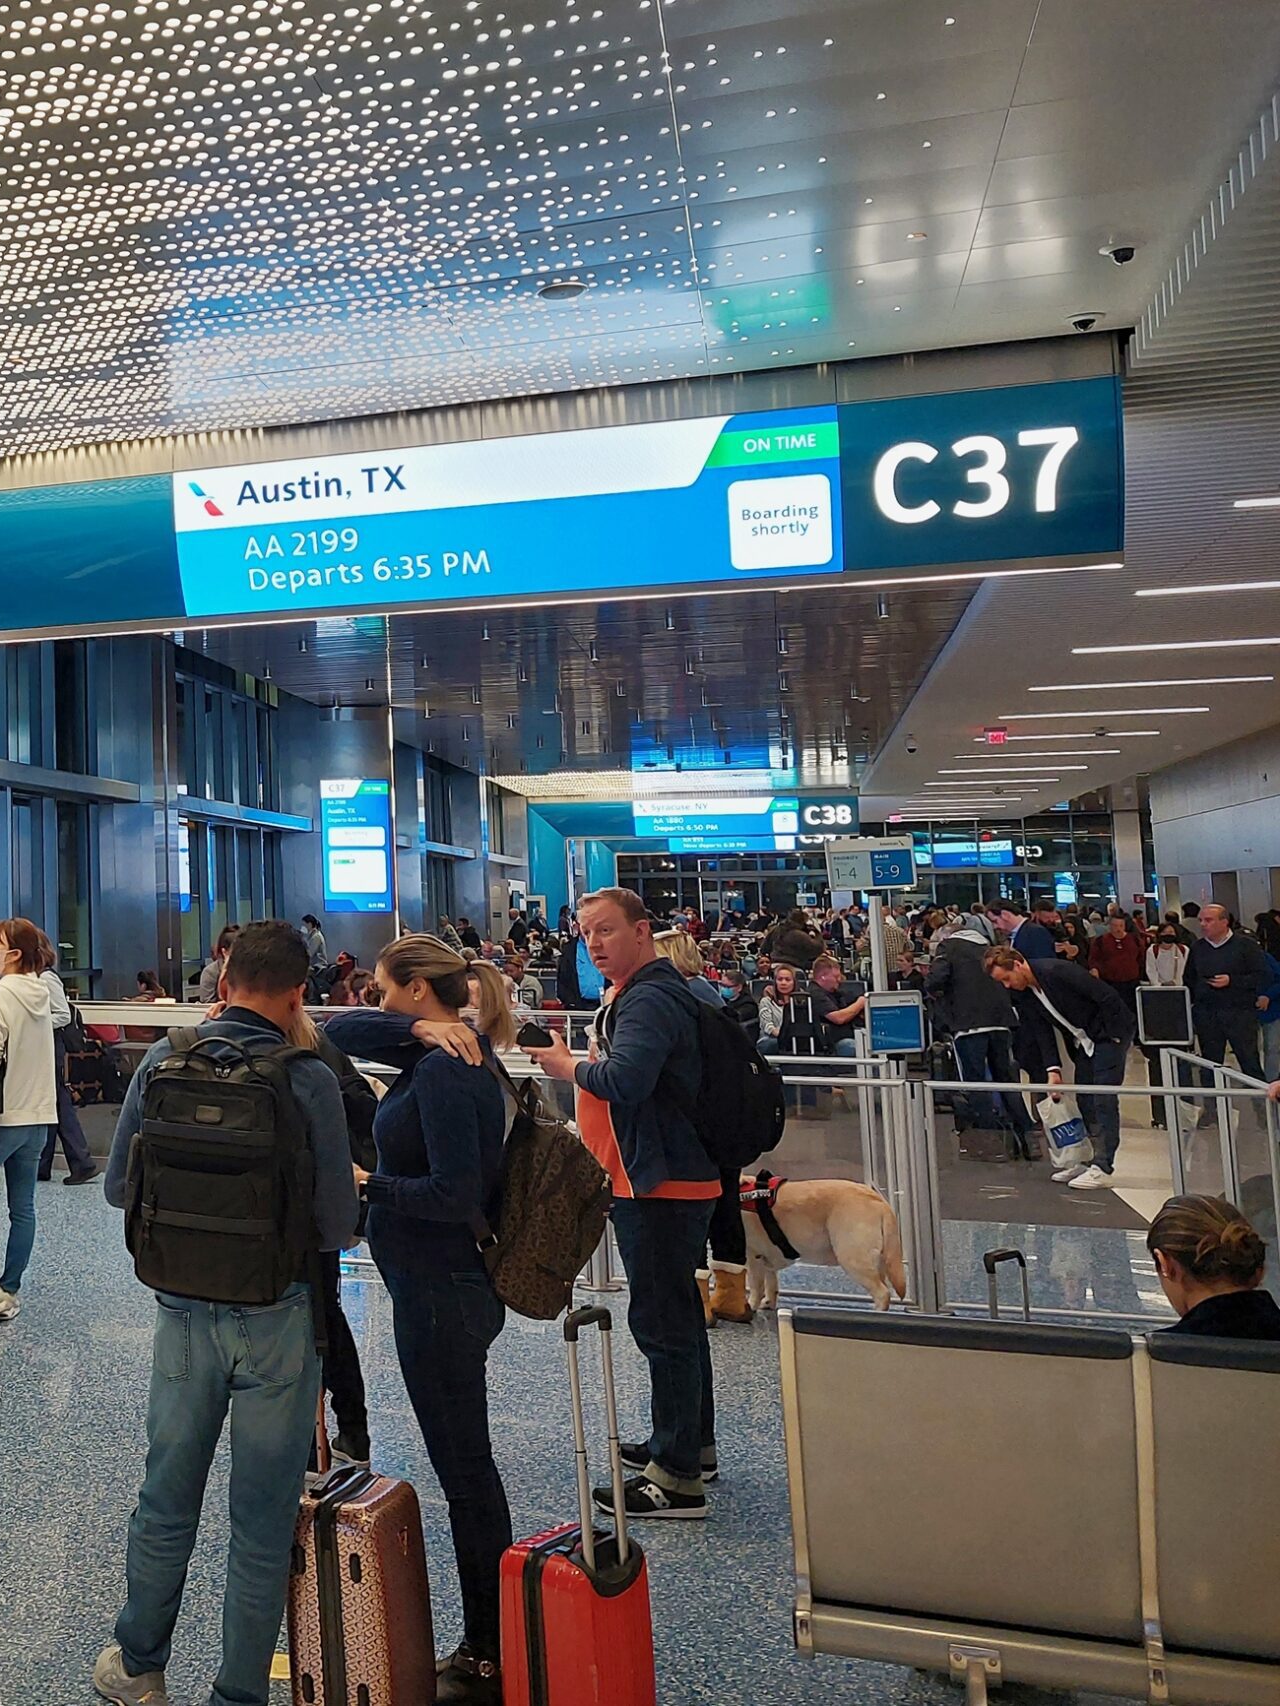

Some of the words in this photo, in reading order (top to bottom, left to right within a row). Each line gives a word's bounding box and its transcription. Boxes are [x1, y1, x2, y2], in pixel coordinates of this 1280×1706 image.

[743, 437, 773, 454] ON
[774, 433, 817, 450] TIME
[236, 471, 352, 506] Austin,
[361, 464, 407, 494] TX
[873, 426, 1079, 525] C37
[741, 502, 819, 522] Boarding
[751, 519, 810, 537] shortly
[243, 535, 286, 561] AA
[292, 527, 359, 557] 2199
[247, 562, 364, 595] Departs
[372, 554, 432, 582] 6:35
[442, 549, 492, 577] PM
[804, 804, 853, 826] C38
[705, 823, 719, 831] PM
